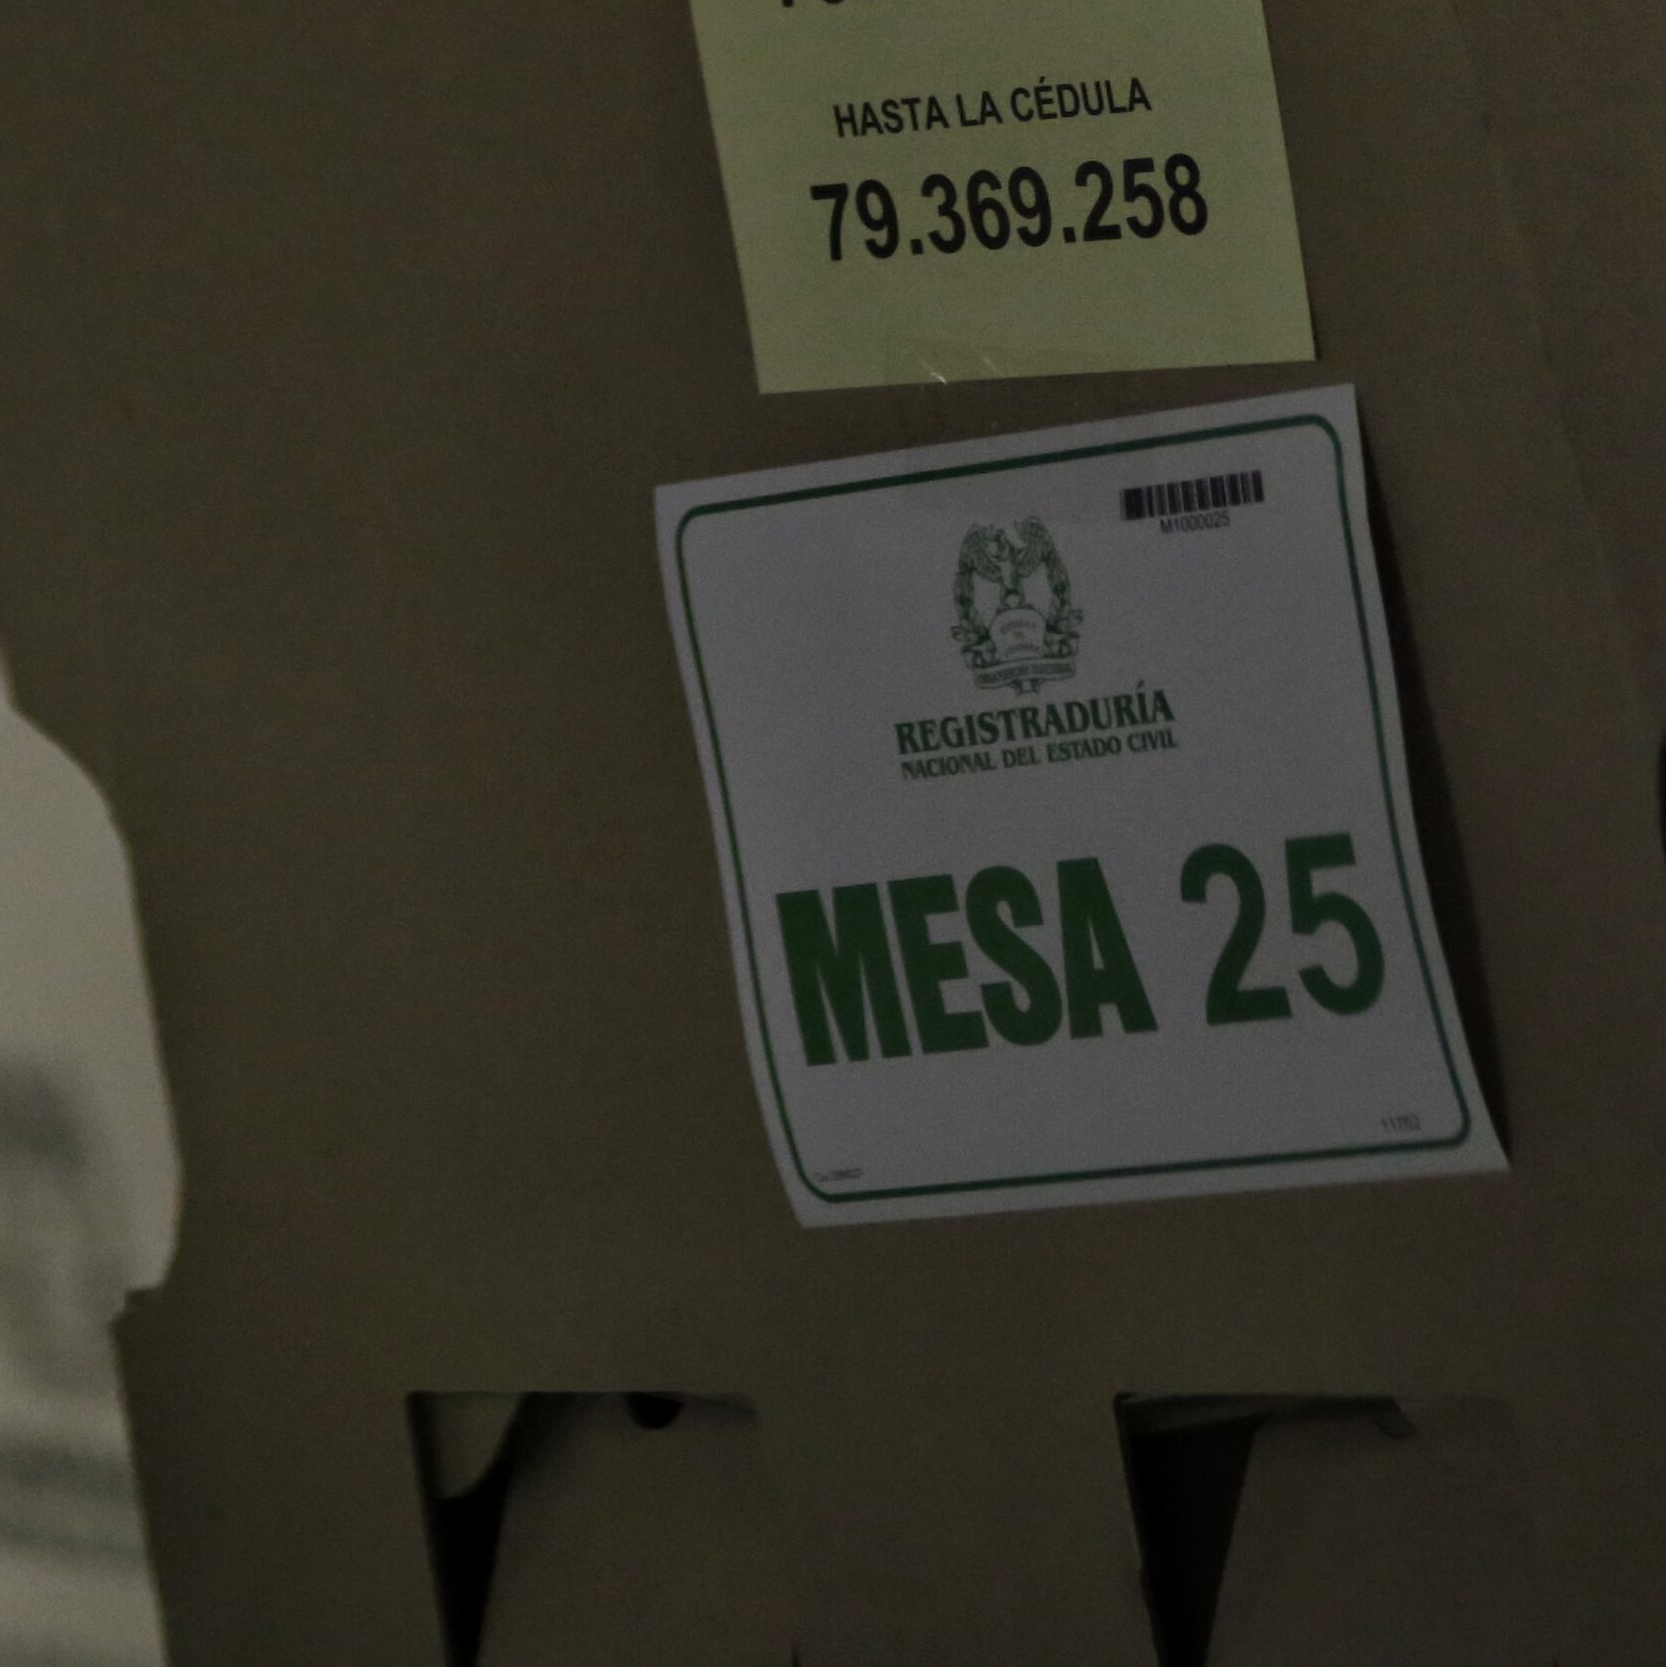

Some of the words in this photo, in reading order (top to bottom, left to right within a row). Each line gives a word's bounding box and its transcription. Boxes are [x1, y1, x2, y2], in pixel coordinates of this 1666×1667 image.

[834, 96, 949, 138] HASTA
[957, 91, 1002, 127] LA
[1010, 77, 1152, 122] CÉDULA
[810, 153, 1209, 262] 79.369.258
[894, 679, 1176, 755] REGISTRADURÍA
[901, 751, 997, 781] NACIONAL
[1002, 746, 1041, 768] DEL
[1046, 736, 1122, 763] ESTADO
[1127, 730, 1179, 753] CIVIL
[776, 857, 1159, 1067] MESA
[1181, 832, 1385, 1026] 25
